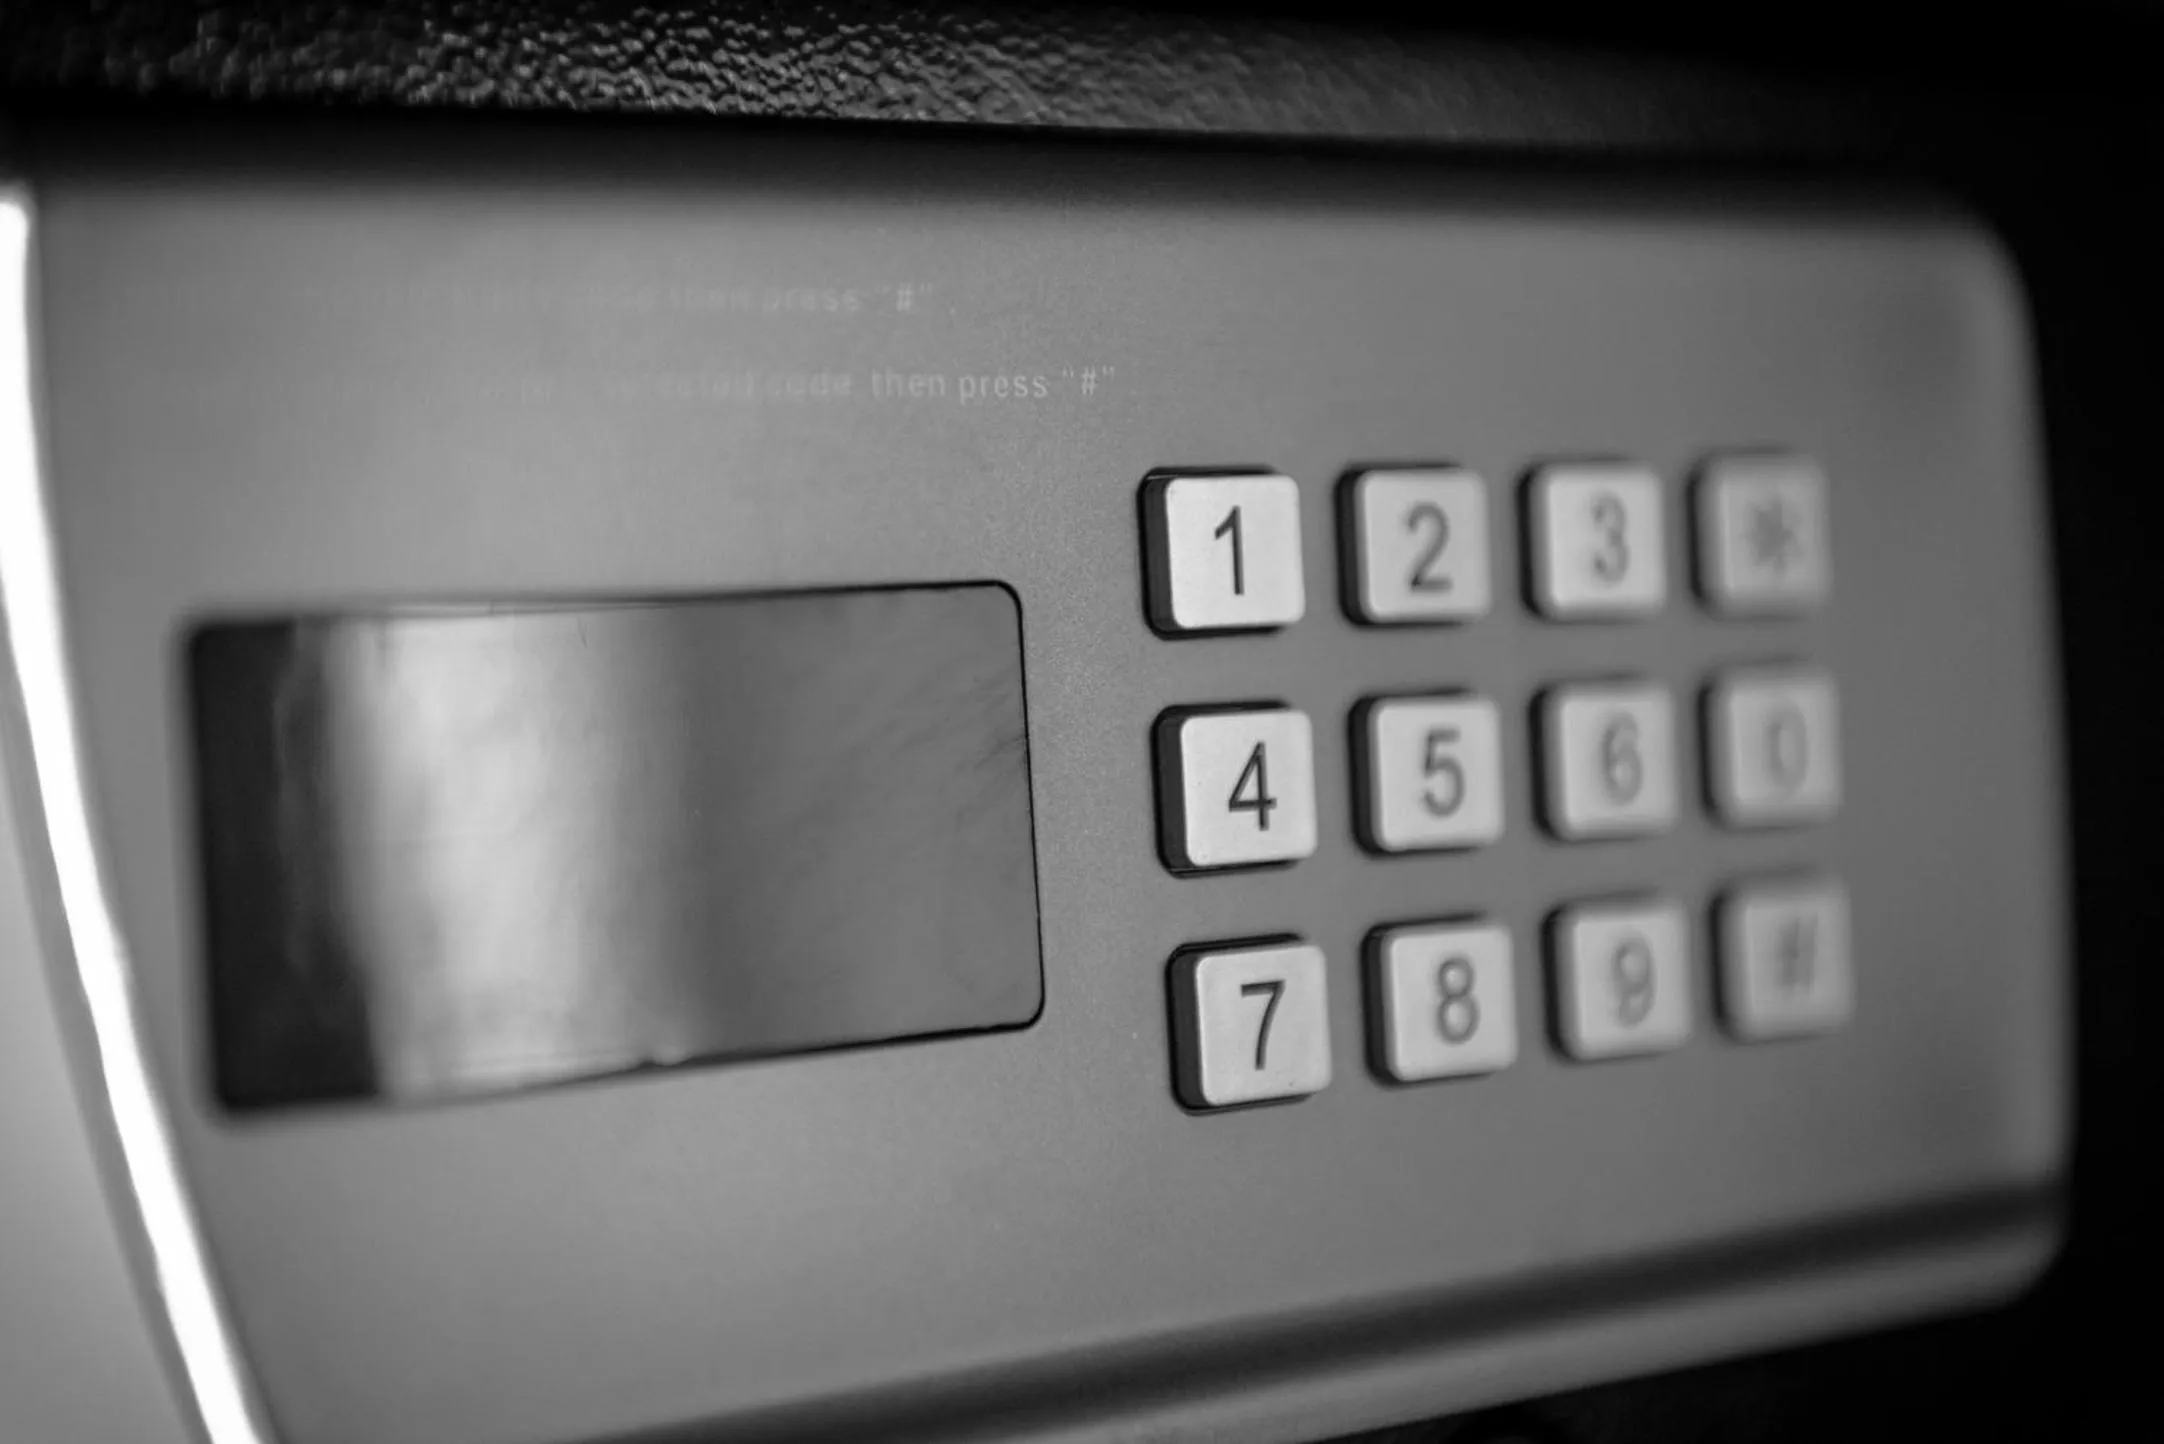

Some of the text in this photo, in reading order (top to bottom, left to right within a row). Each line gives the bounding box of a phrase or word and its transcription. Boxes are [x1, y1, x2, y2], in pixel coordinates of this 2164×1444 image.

[870, 367, 947, 398] then
[958, 373, 1049, 405] press
[1213, 505, 1245, 596] 1
[1406, 503, 1454, 594] 2
[1591, 491, 1631, 586] 3
[1228, 741, 1277, 832] 4
[1422, 728, 1466, 818] 5
[1602, 712, 1643, 806] 6
[1240, 978, 1286, 1071] 7
[1434, 956, 1480, 1045] 8
[1612, 932, 1656, 1028] 9
